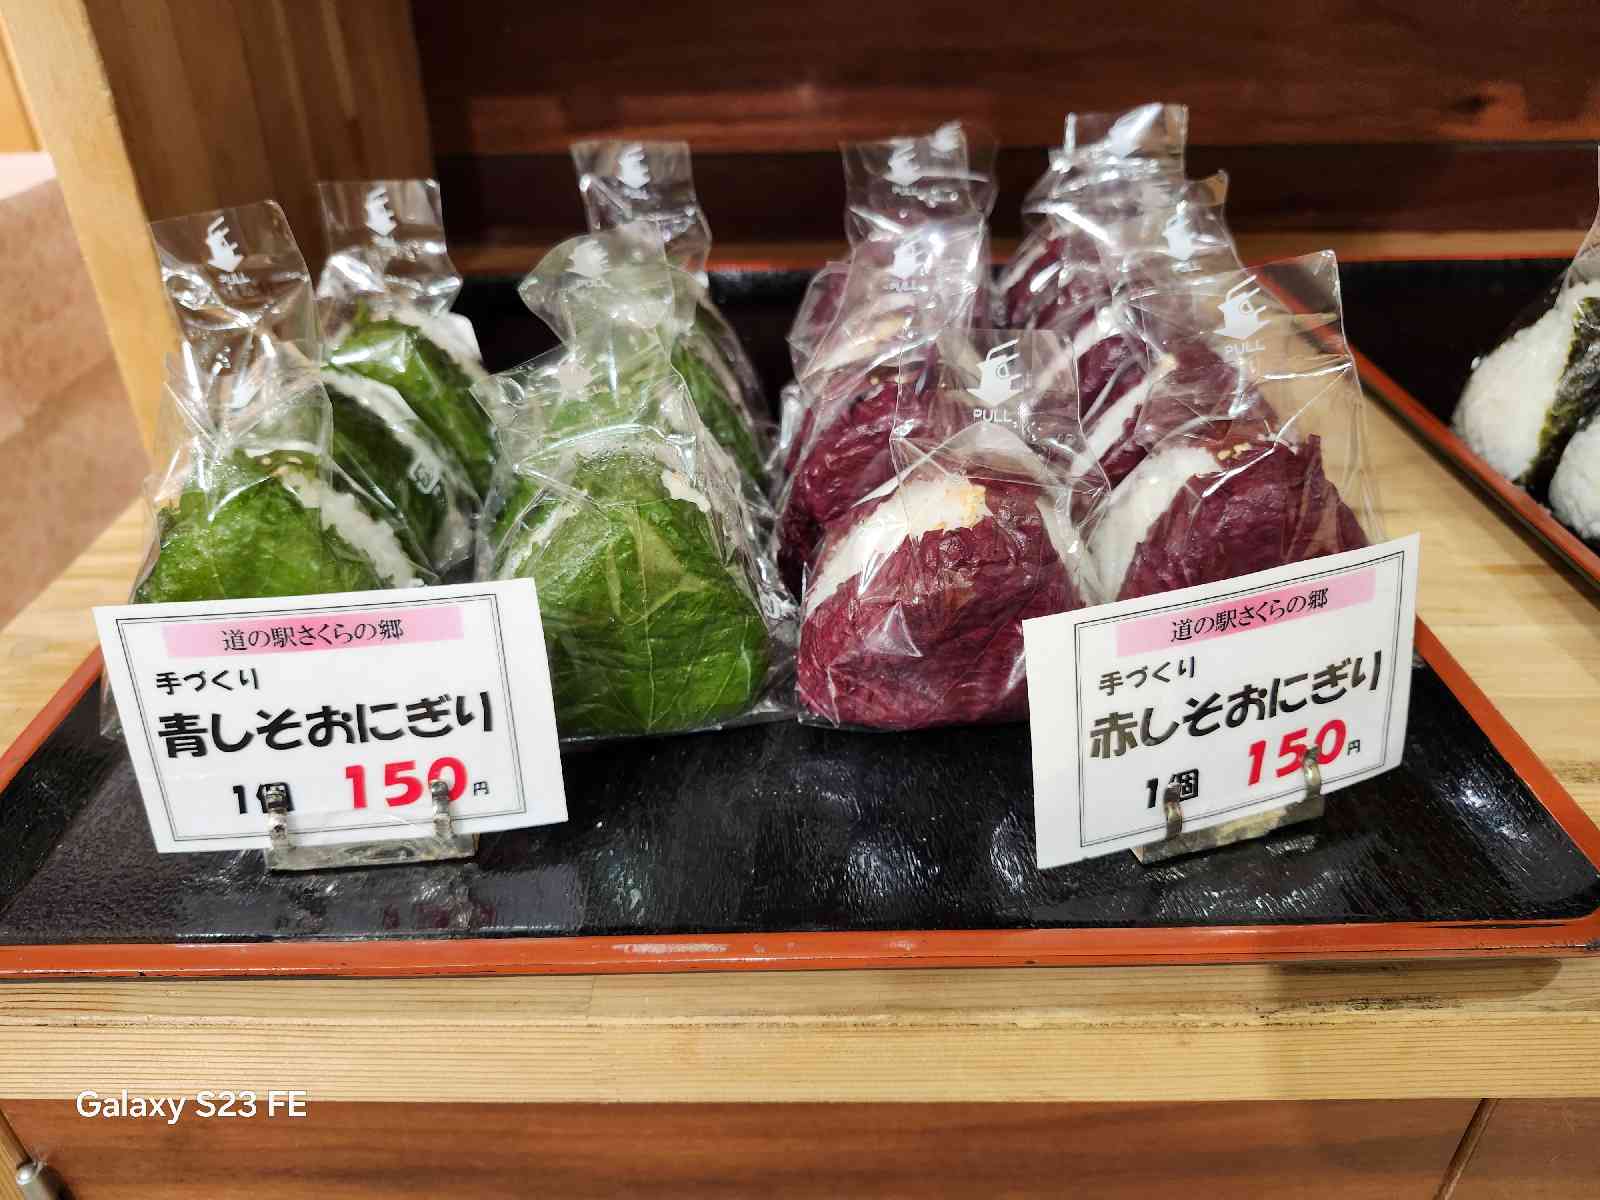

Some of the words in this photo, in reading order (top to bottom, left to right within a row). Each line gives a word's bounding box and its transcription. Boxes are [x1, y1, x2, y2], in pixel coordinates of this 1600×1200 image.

[1223, 339, 1265, 354] PULL
[972, 407, 1012, 424] PULL
[1170, 587, 1329, 642] 道の駅さくらの郷
[222, 618, 404, 652] 道の駅さくらの郷
[155, 667, 260, 695] 手づくり
[1099, 655, 1196, 697] 手づくり
[1090, 650, 1382, 760] 赤しそおにぎり
[157, 690, 493, 759] 青しそおにぎり
